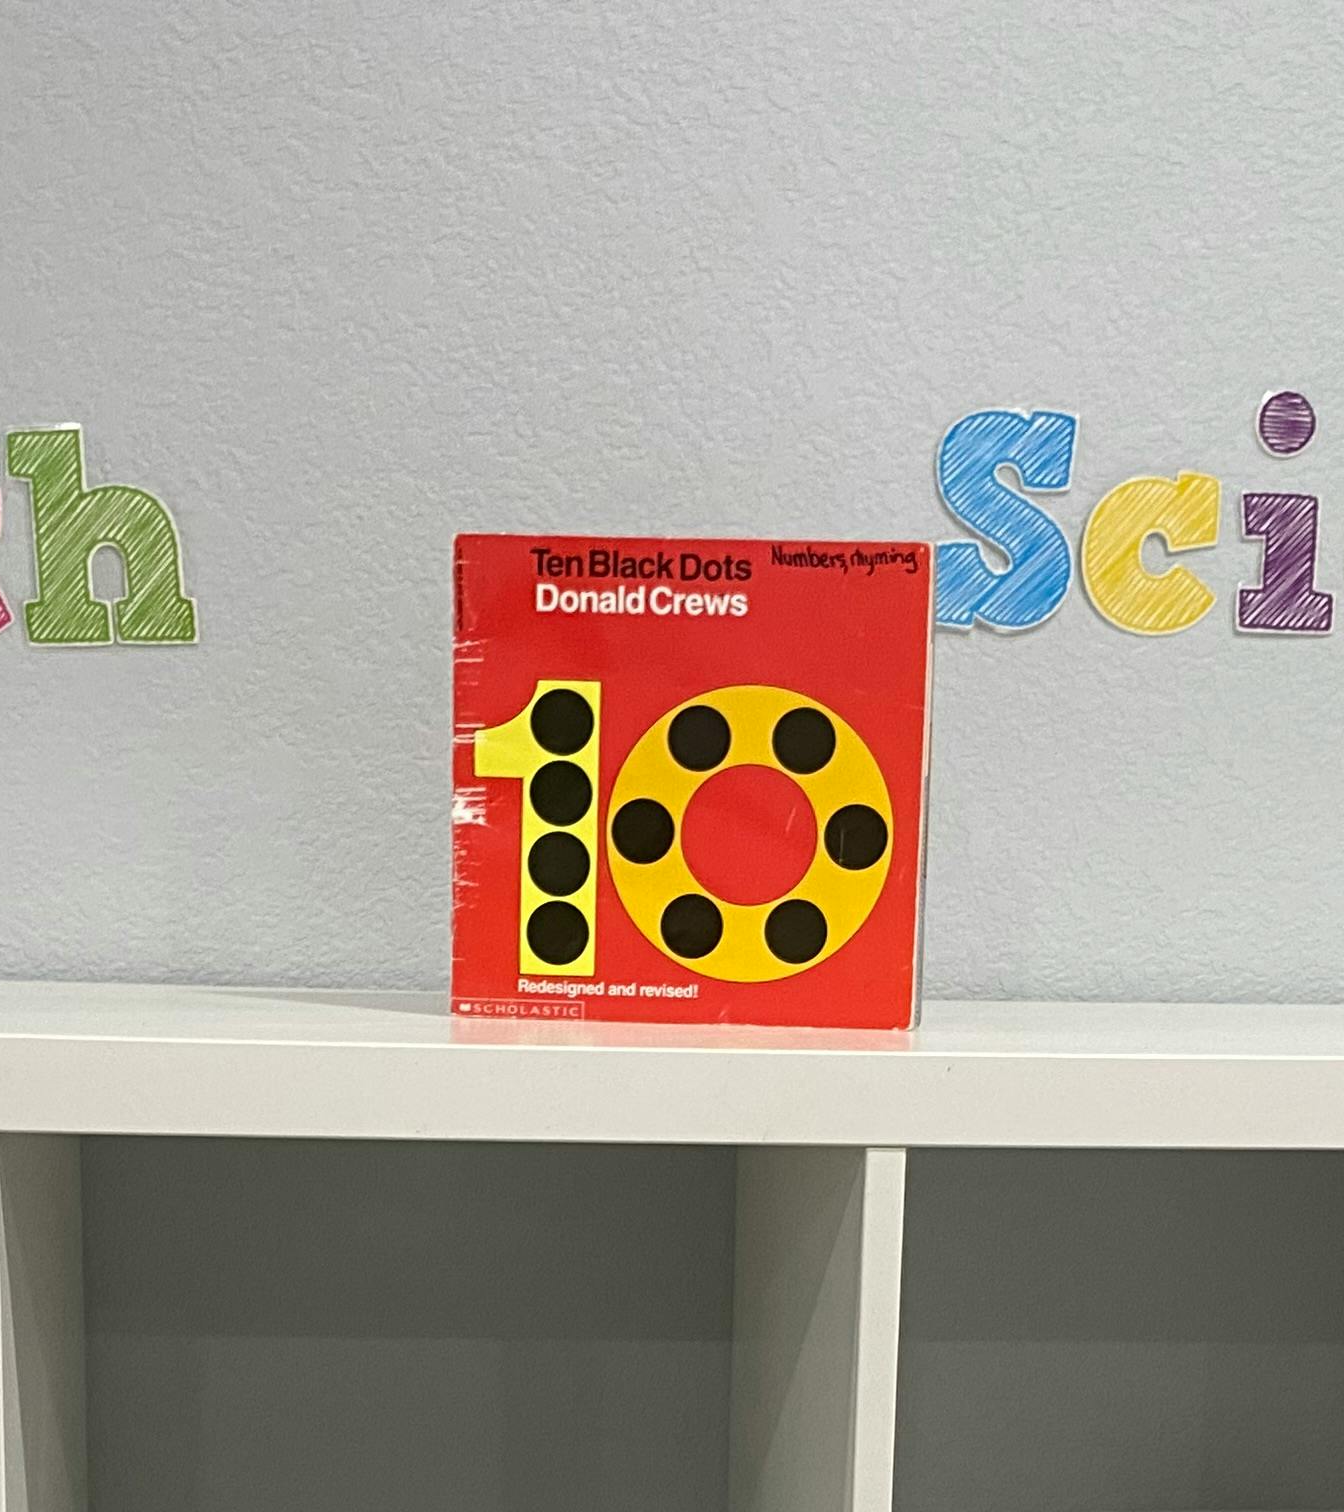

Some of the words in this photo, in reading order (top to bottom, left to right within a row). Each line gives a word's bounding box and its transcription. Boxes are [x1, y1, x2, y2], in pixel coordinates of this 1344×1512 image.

[534, 548, 584, 579] Ten
[589, 550, 675, 581] Black
[680, 553, 753, 582] Dots
[850, 547, 919, 576] rhyming
[535, 585, 647, 615] Donald
[650, 586, 749, 616] Crews
[474, 679, 894, 983] 10
[517, 978, 605, 998] Redesigned
[608, 982, 637, 997] and
[639, 983, 699, 998] revised!
[473, 1003, 579, 1018] SCHOLASTIC
